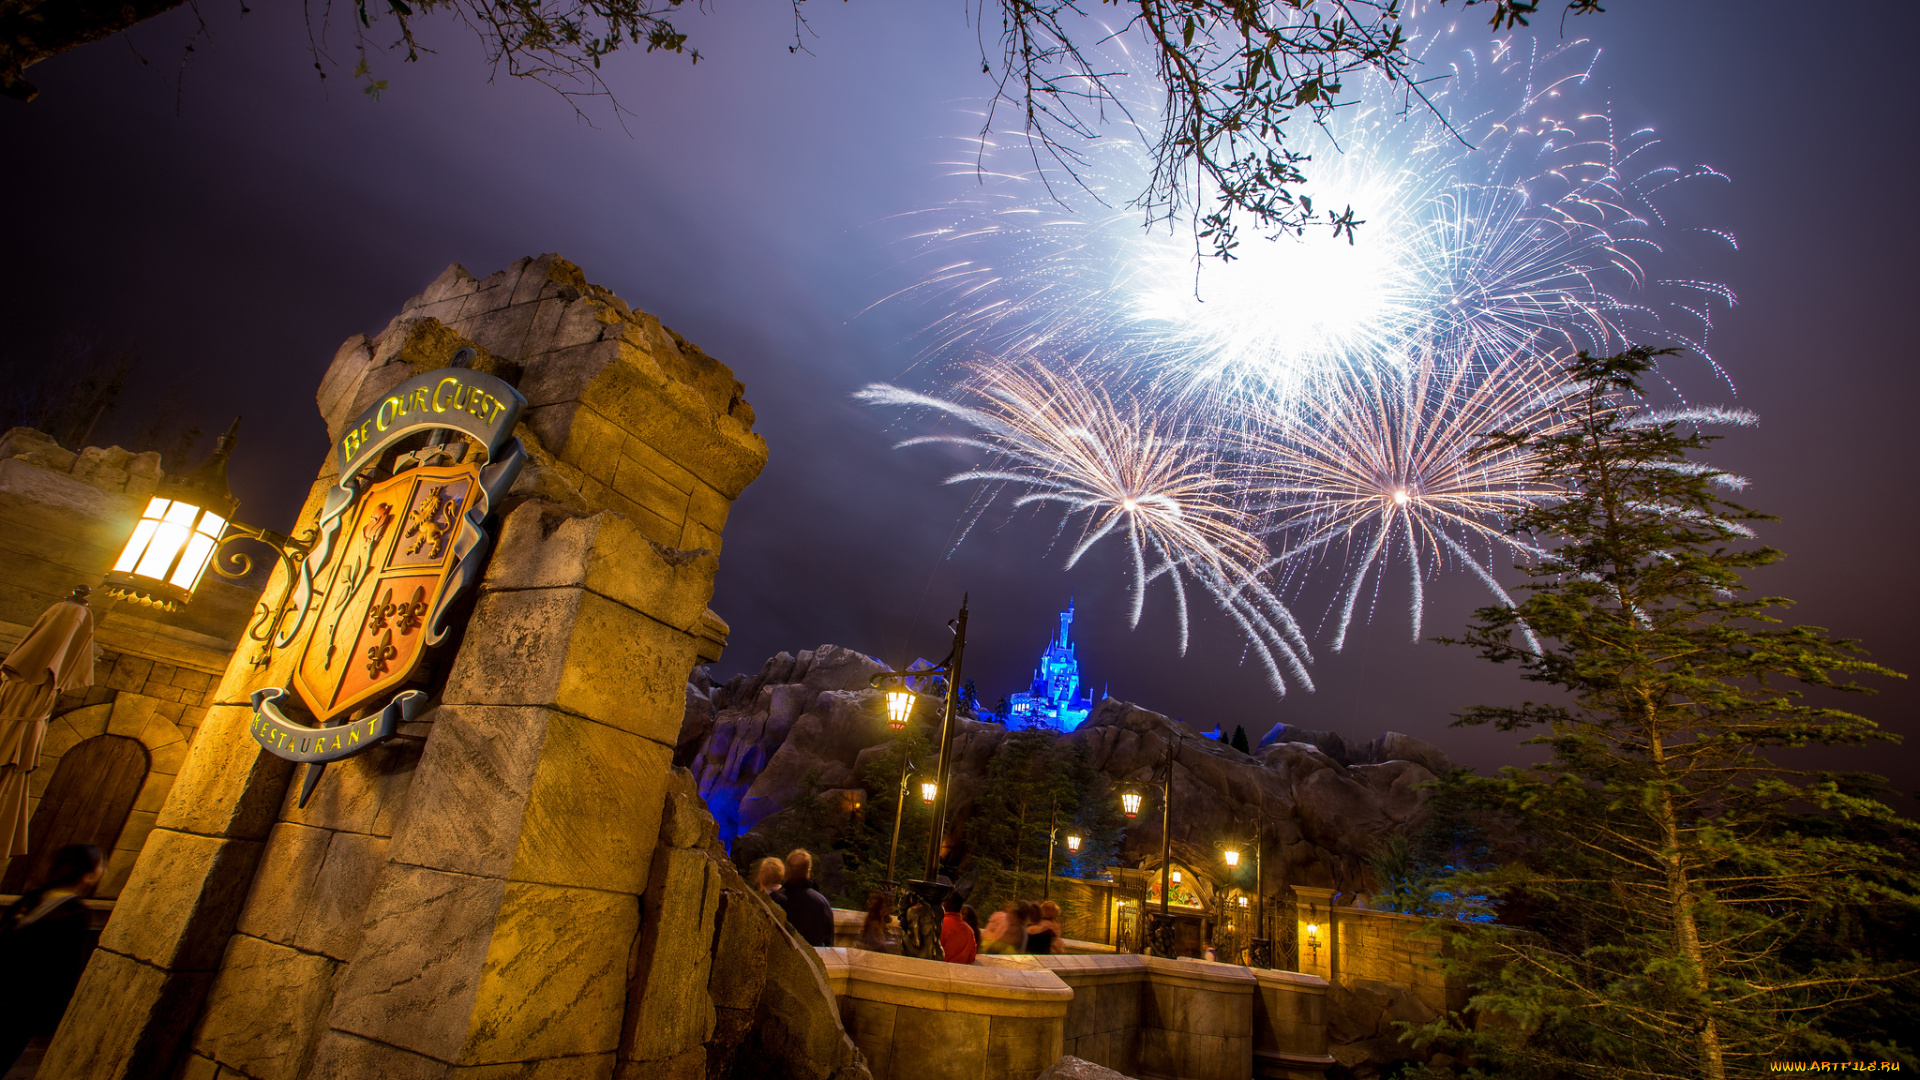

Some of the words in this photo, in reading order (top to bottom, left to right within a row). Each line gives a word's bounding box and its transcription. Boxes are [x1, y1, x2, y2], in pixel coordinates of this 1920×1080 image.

[342, 418, 372, 465] BE
[376, 386, 429, 432] OUR
[432, 377, 506, 427] GUEST
[252, 712, 379, 755] RESTAURANT
